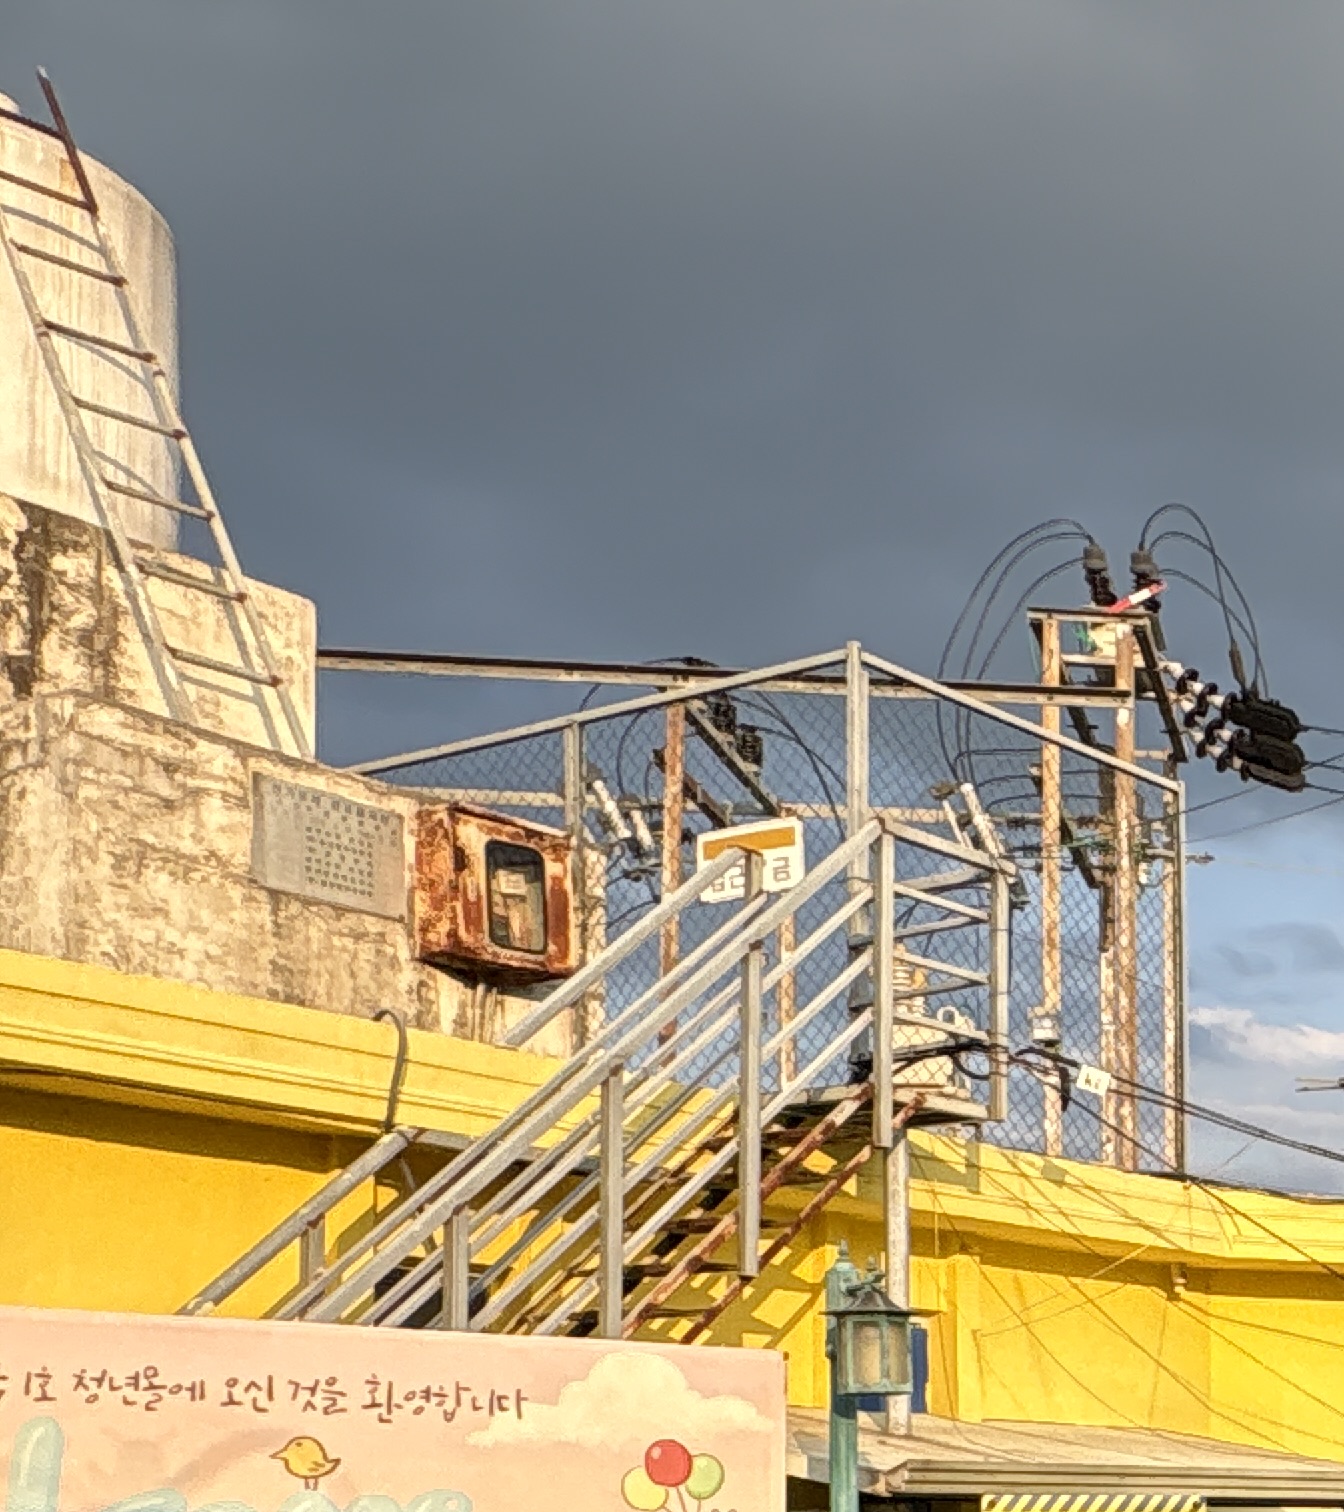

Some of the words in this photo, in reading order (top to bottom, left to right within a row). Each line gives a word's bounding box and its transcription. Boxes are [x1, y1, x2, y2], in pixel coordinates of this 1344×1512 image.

[220, 1374, 274, 1413] 오신
[288, 1376, 347, 1416] 것을
[361, 1373, 529, 1424] 환영합니다
